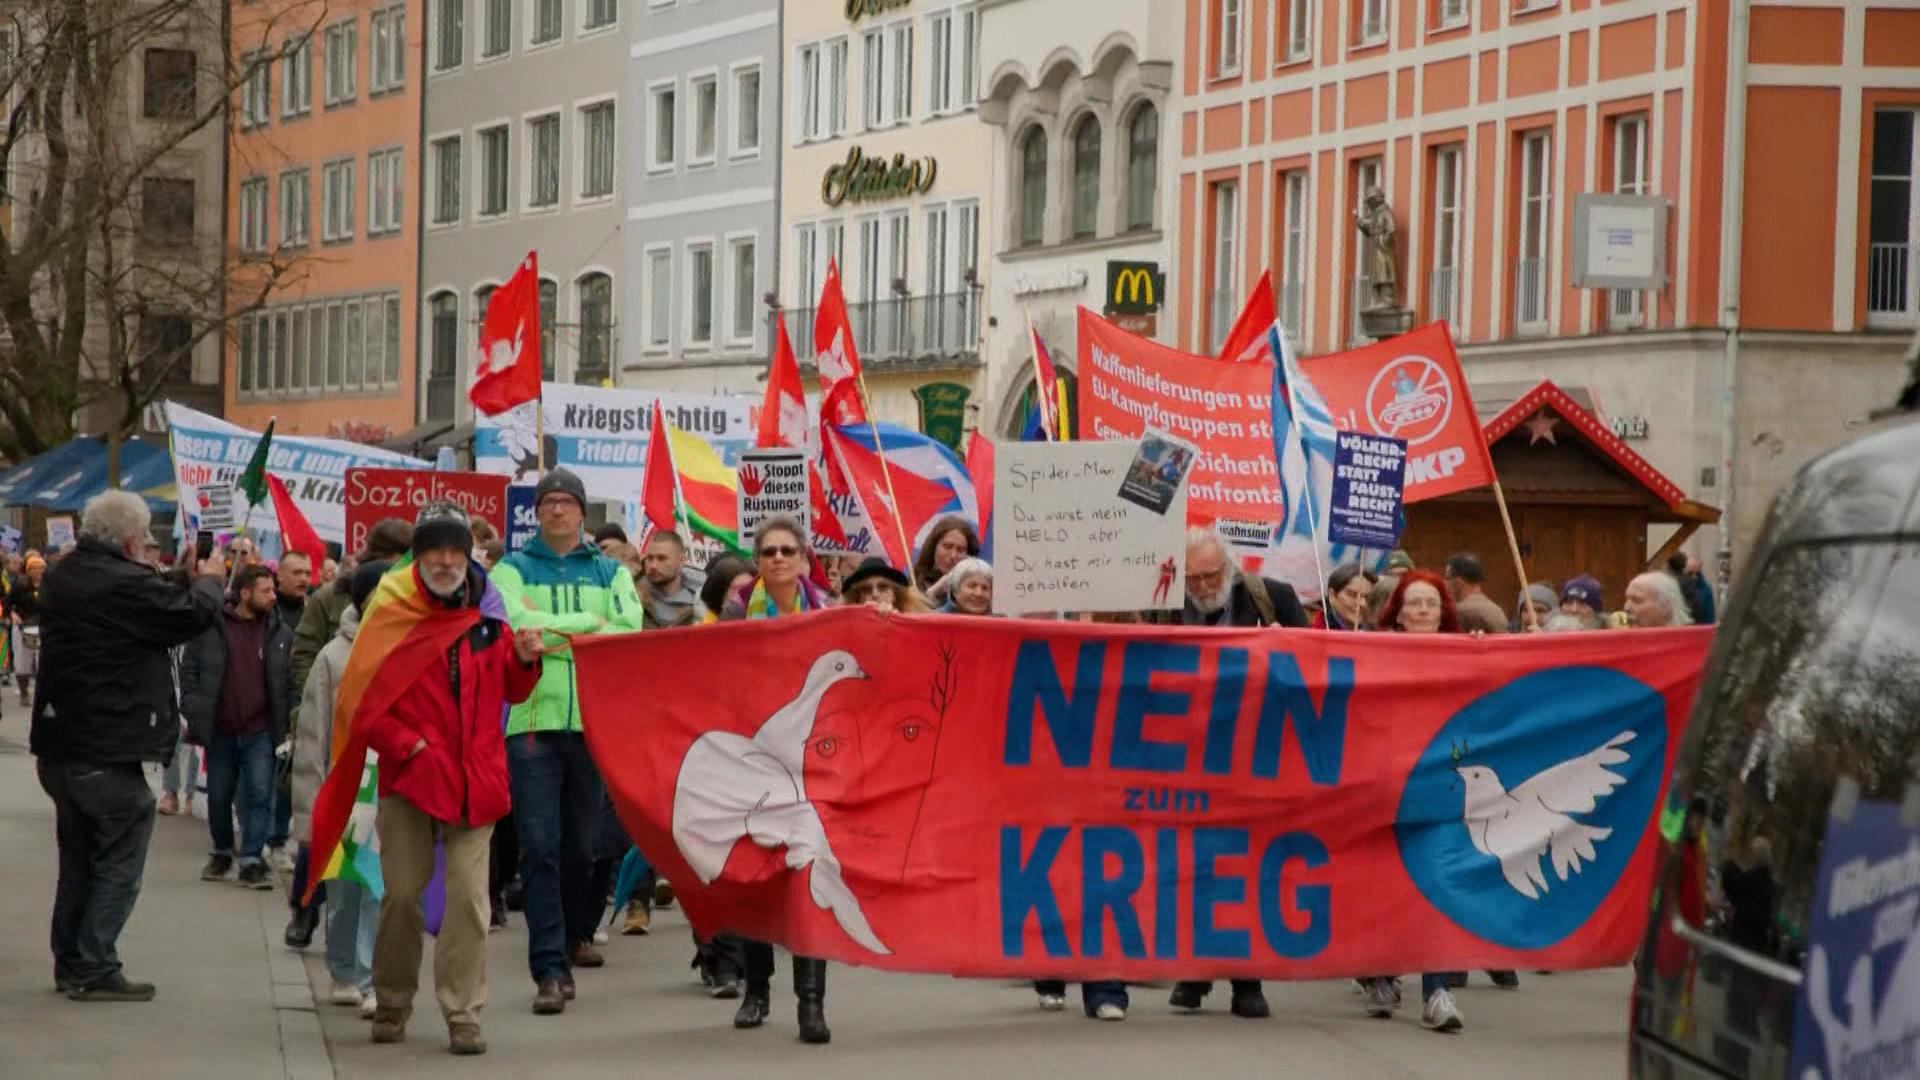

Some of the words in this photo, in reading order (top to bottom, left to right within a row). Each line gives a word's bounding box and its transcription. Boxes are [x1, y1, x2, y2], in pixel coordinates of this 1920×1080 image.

[1091, 343, 1242, 410] Waffenlieferungen
[564, 403, 727, 434] Kriegstchtig
[1092, 376, 1243, 439] EU-Kampfgruppen
[1340, 435, 1406, 457] VÖLKER-
[763, 463, 804, 478] Stoppt
[1197, 450, 1277, 475] Sicherh
[1337, 465, 1380, 481] STATT
[1352, 453, 1400, 471] RECHT
[348, 470, 497, 515] Sozialismus
[763, 477, 805, 494] diesen
[1188, 481, 1283, 504] onfronta
[1349, 480, 1400, 498] FAUST-
[743, 497, 804, 512] Rüstungs-
[1013, 504, 1035, 522] Du
[1348, 494, 1395, 512] RECHT
[1015, 529, 1069, 542] HELD
[1088, 528, 1120, 542] aber
[1003, 639, 1355, 786] NEIN
[1122, 786, 1210, 814] zum
[1000, 825, 1332, 960] KRIEG
